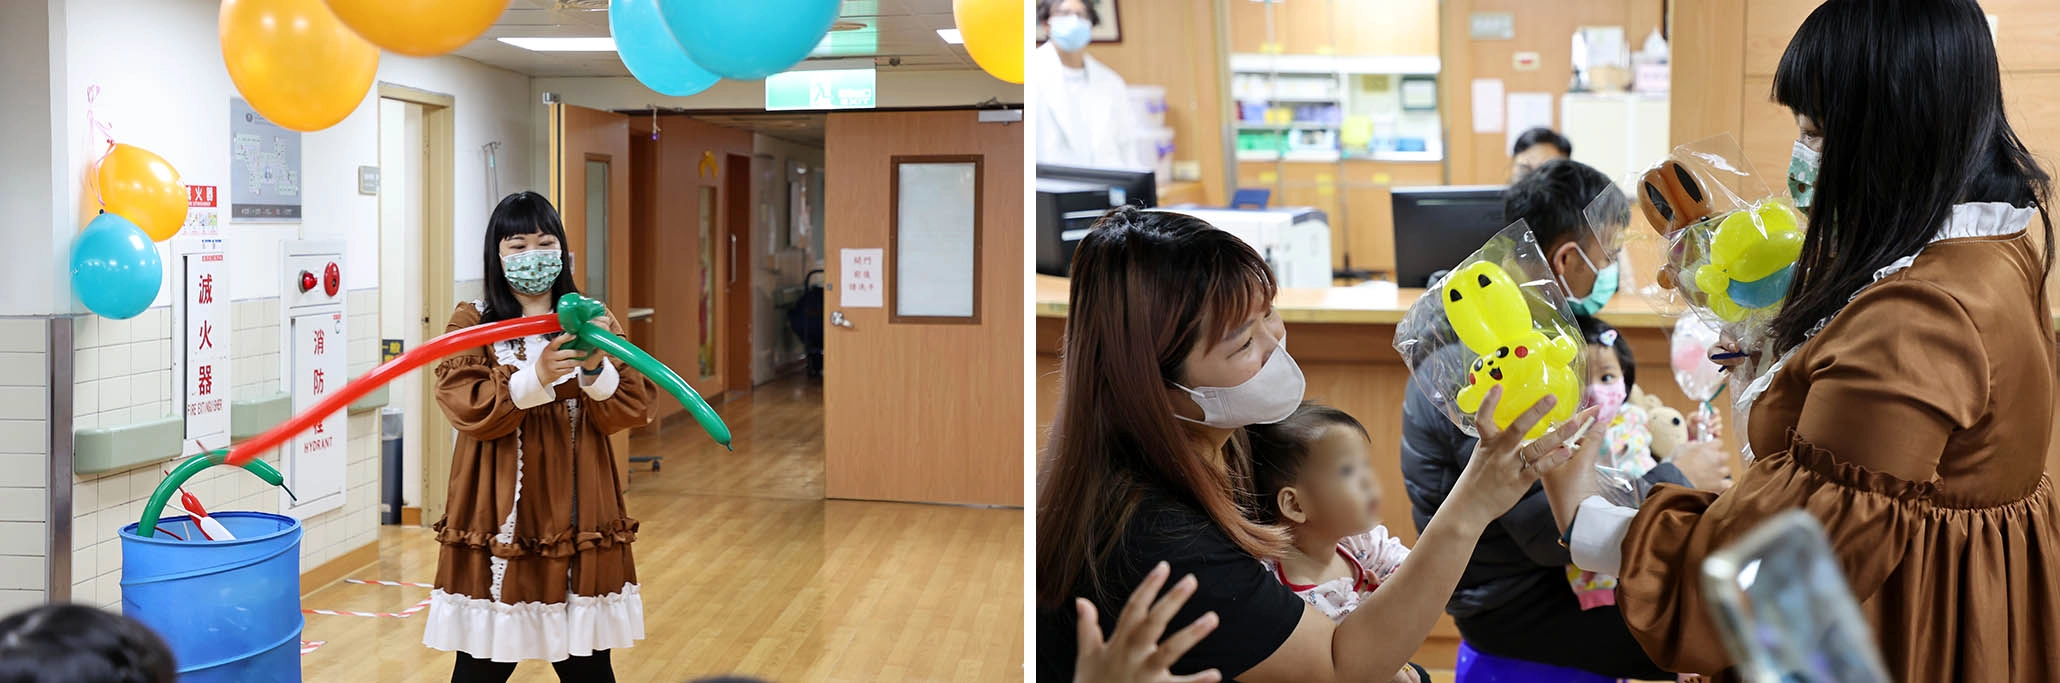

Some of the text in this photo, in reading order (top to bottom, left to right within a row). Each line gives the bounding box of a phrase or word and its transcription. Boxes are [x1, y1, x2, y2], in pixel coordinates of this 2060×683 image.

[199, 274, 213, 396] 滅火器
[303, 436, 333, 454] HYDRANT
